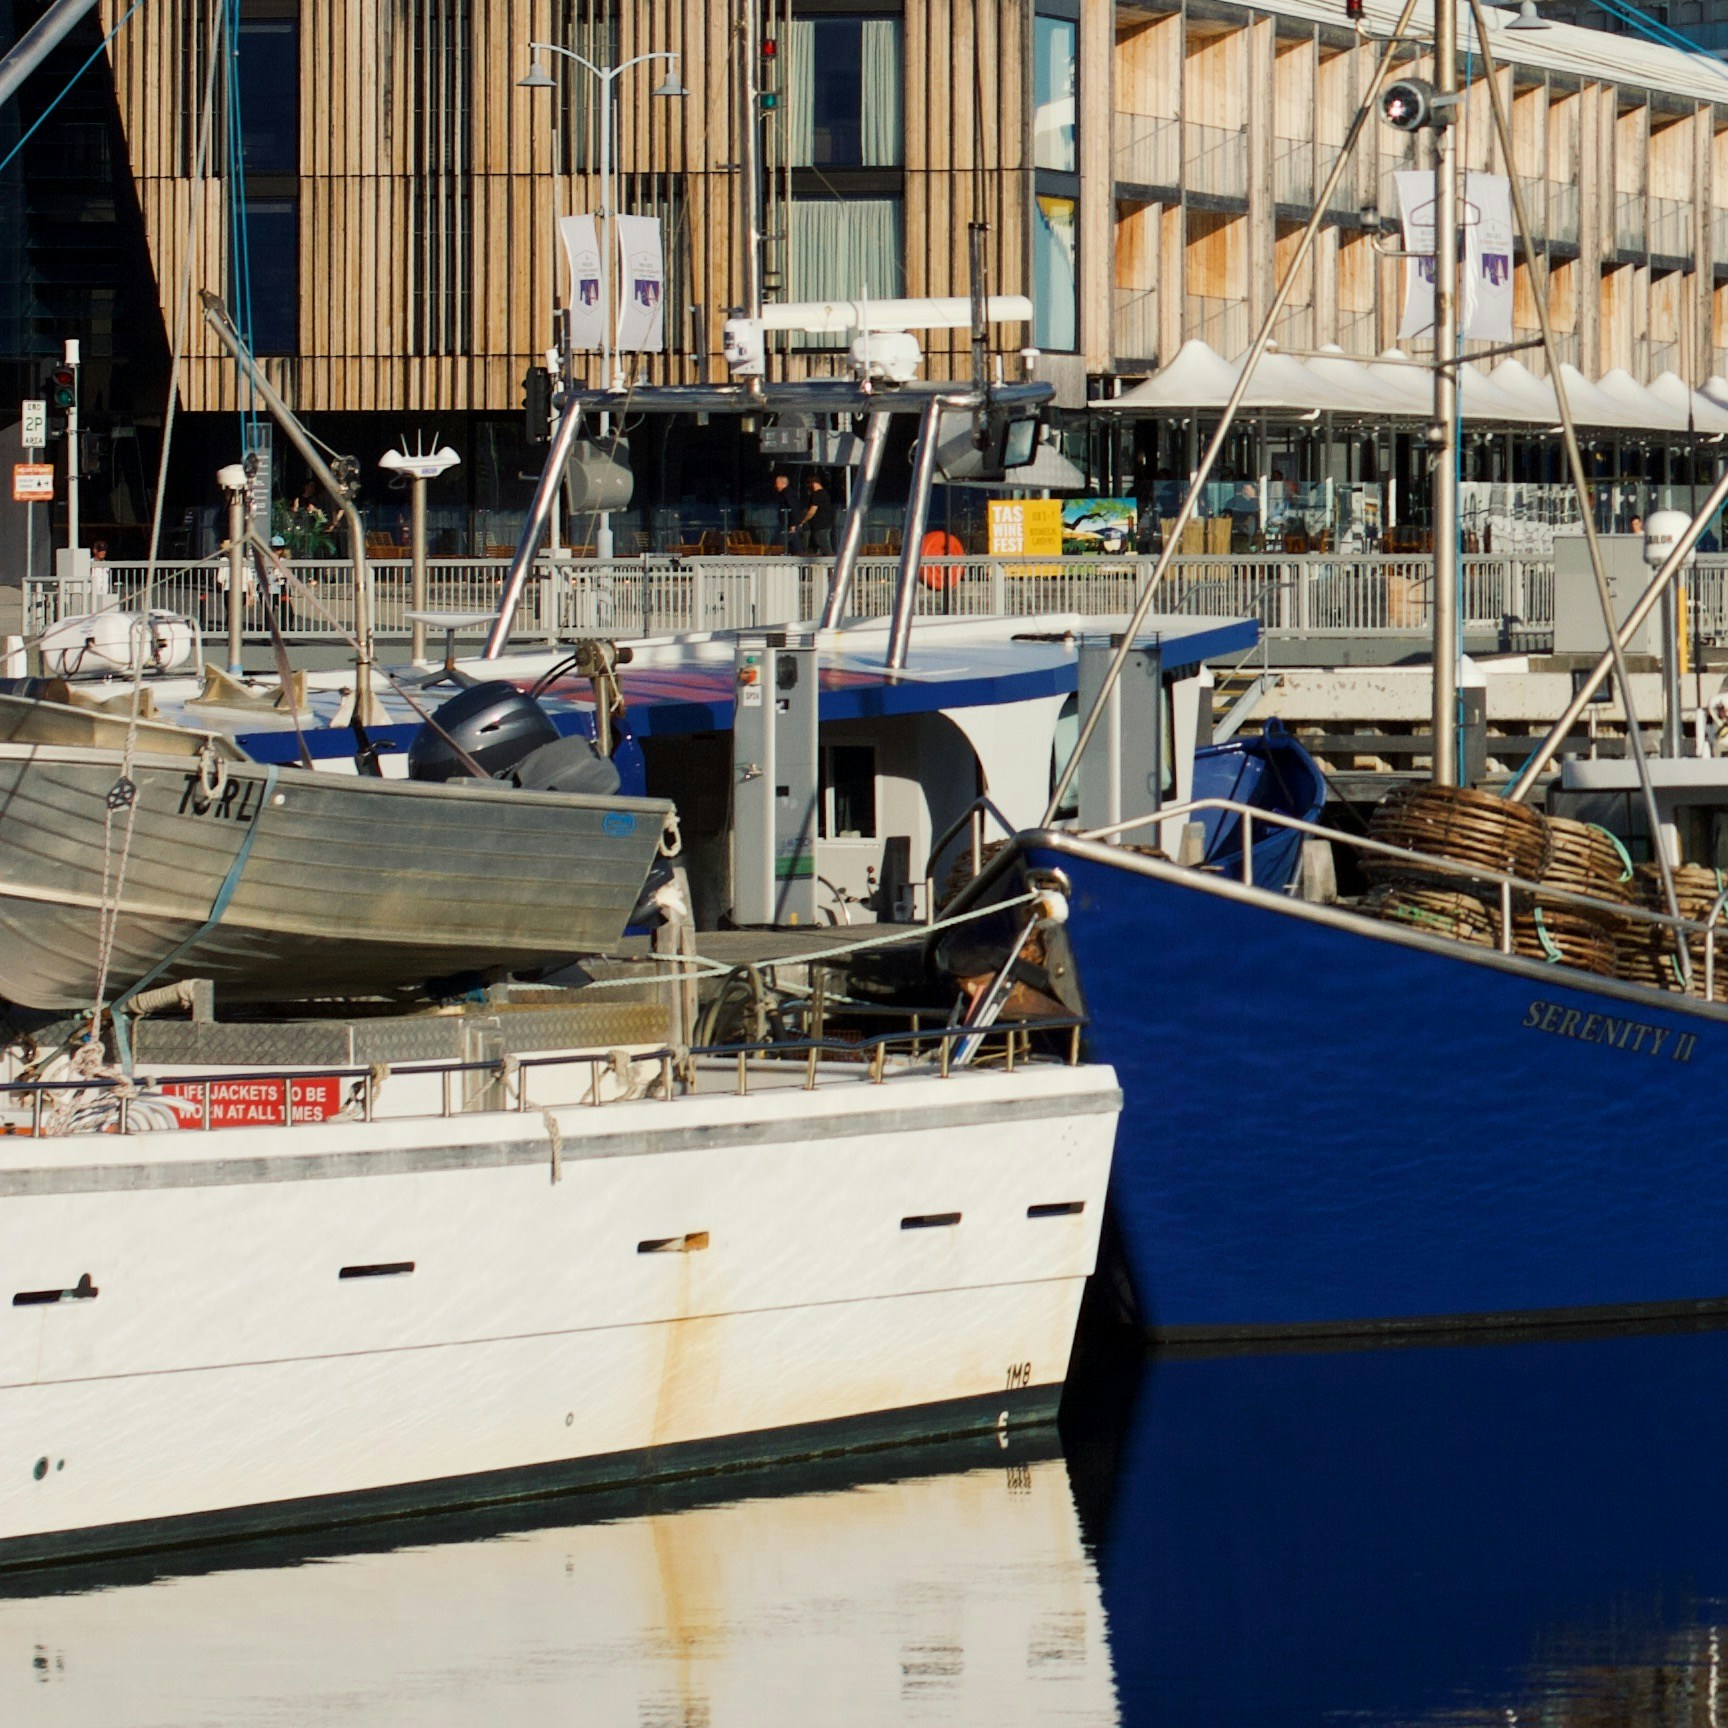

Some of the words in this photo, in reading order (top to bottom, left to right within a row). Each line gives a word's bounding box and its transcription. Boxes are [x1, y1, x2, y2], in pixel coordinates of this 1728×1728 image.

[26, 416, 43, 432] 2P
[25, 436, 43, 445] AREA
[991, 505, 1024, 522] TAS
[992, 522, 1024, 538] WINE
[992, 537, 1025, 553] FEST
[1521, 1000, 1672, 1056] SERENITY
[1671, 1032, 1698, 1062] II
[174, 1085, 205, 1101] LIFE
[210, 1085, 278, 1101] JACKETS
[305, 1087, 327, 1103] BE
[178, 1104, 224, 1120] WON
[226, 1105, 246, 1120] AT
[247, 1105, 276, 1121] ALL
[278, 1106, 324, 1122] TMES
